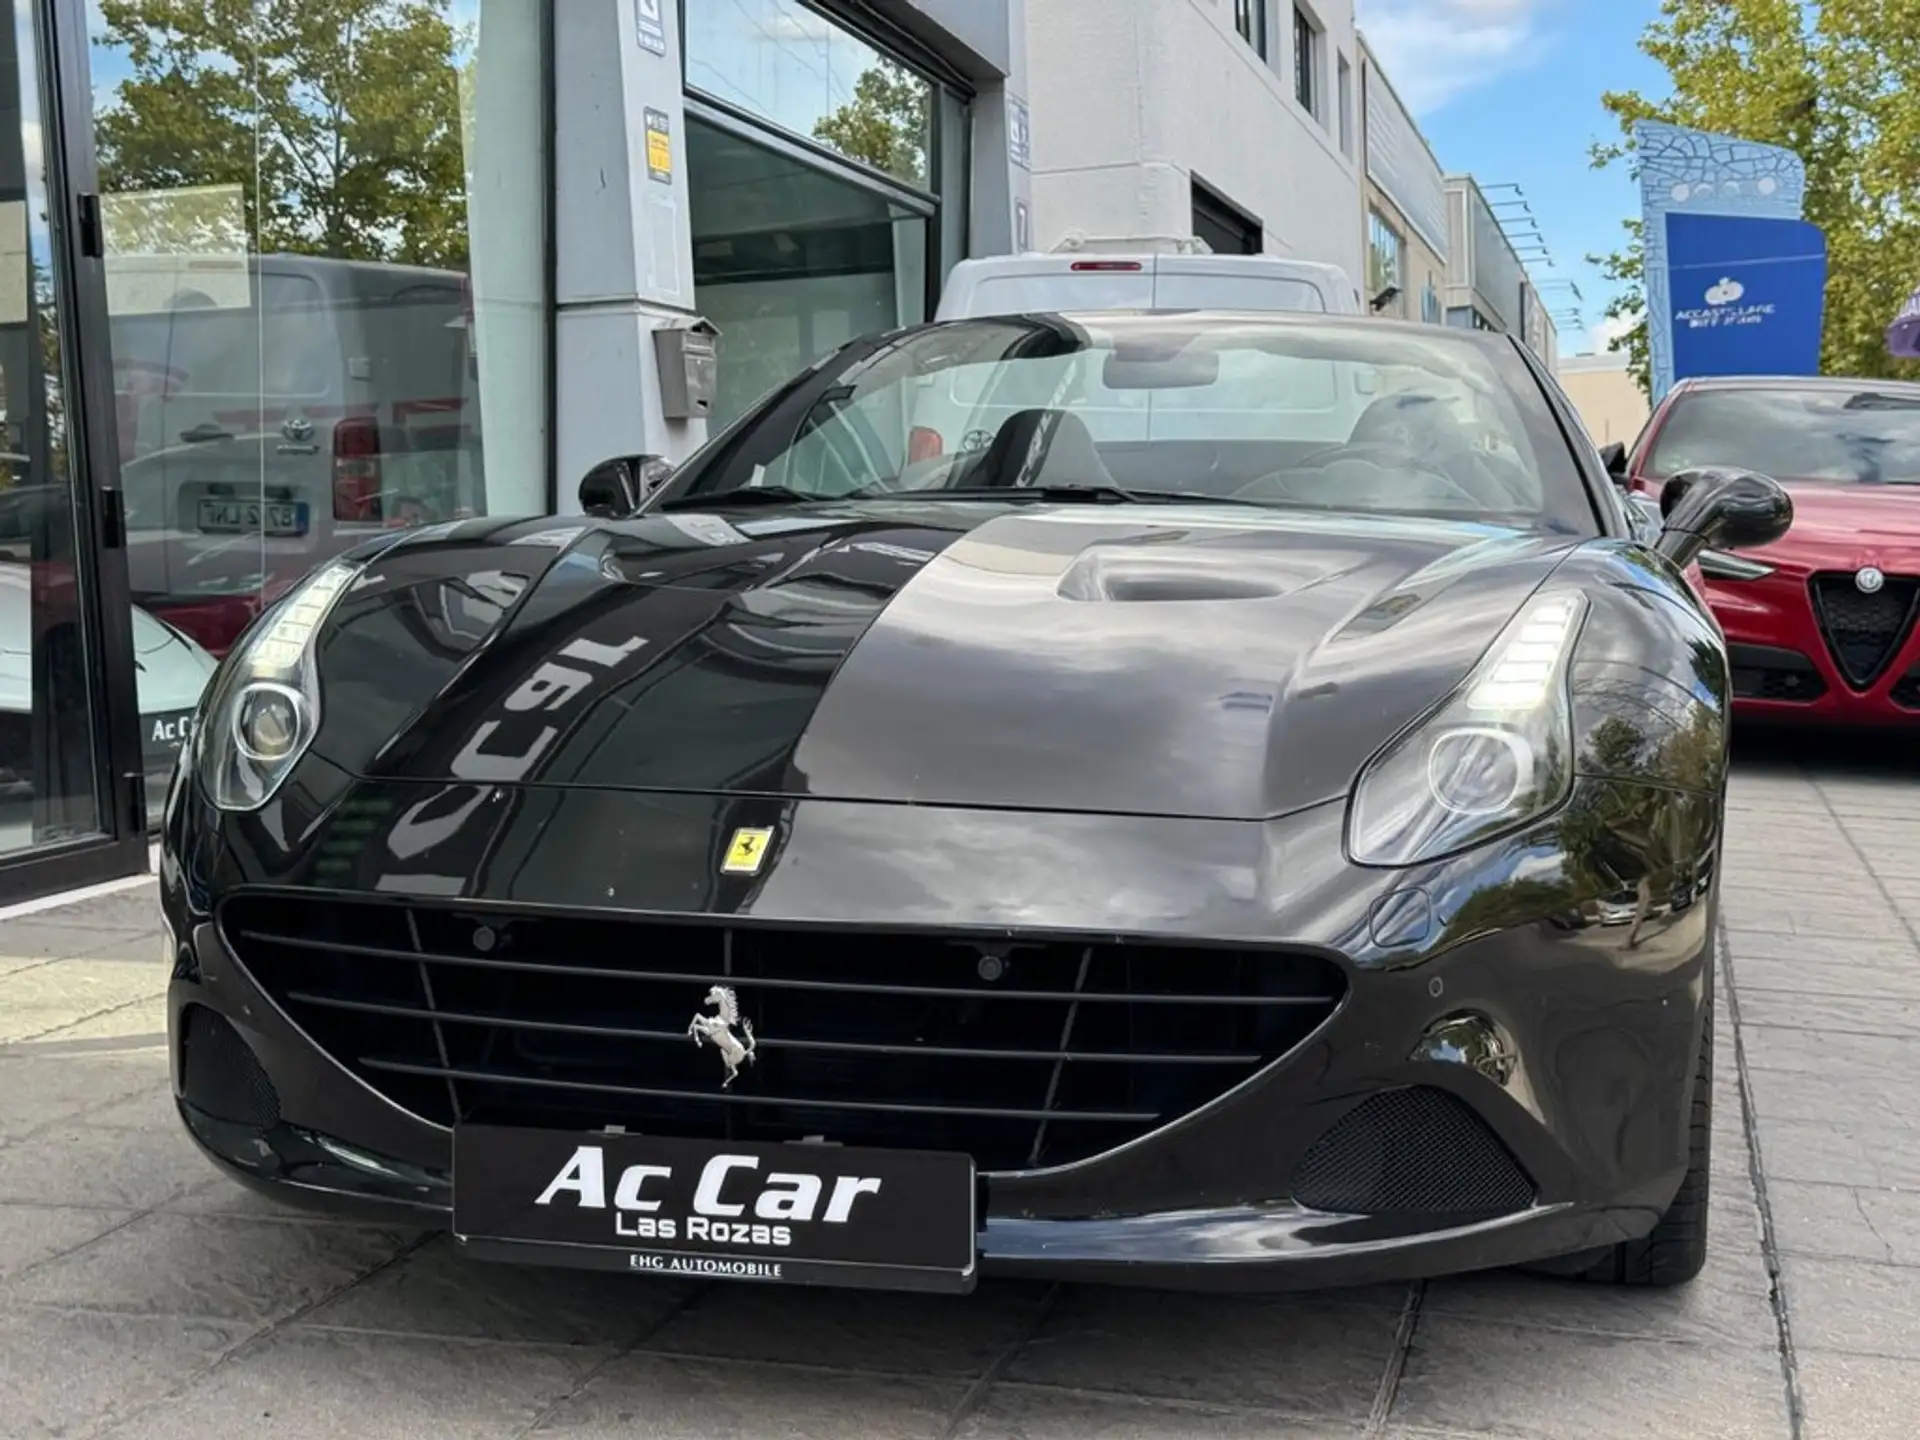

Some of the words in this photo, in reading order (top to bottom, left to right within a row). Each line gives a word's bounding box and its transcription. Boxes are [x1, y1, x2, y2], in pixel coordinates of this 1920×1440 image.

[151, 719, 176, 742] Ac
[535, 1146, 672, 1211] Ac
[693, 1154, 881, 1223] Car
[615, 1211, 677, 1238] Las
[686, 1216, 792, 1246] Rozas
[629, 1254, 664, 1269] EHG
[670, 1257, 782, 1277] AUTOMOBILE
